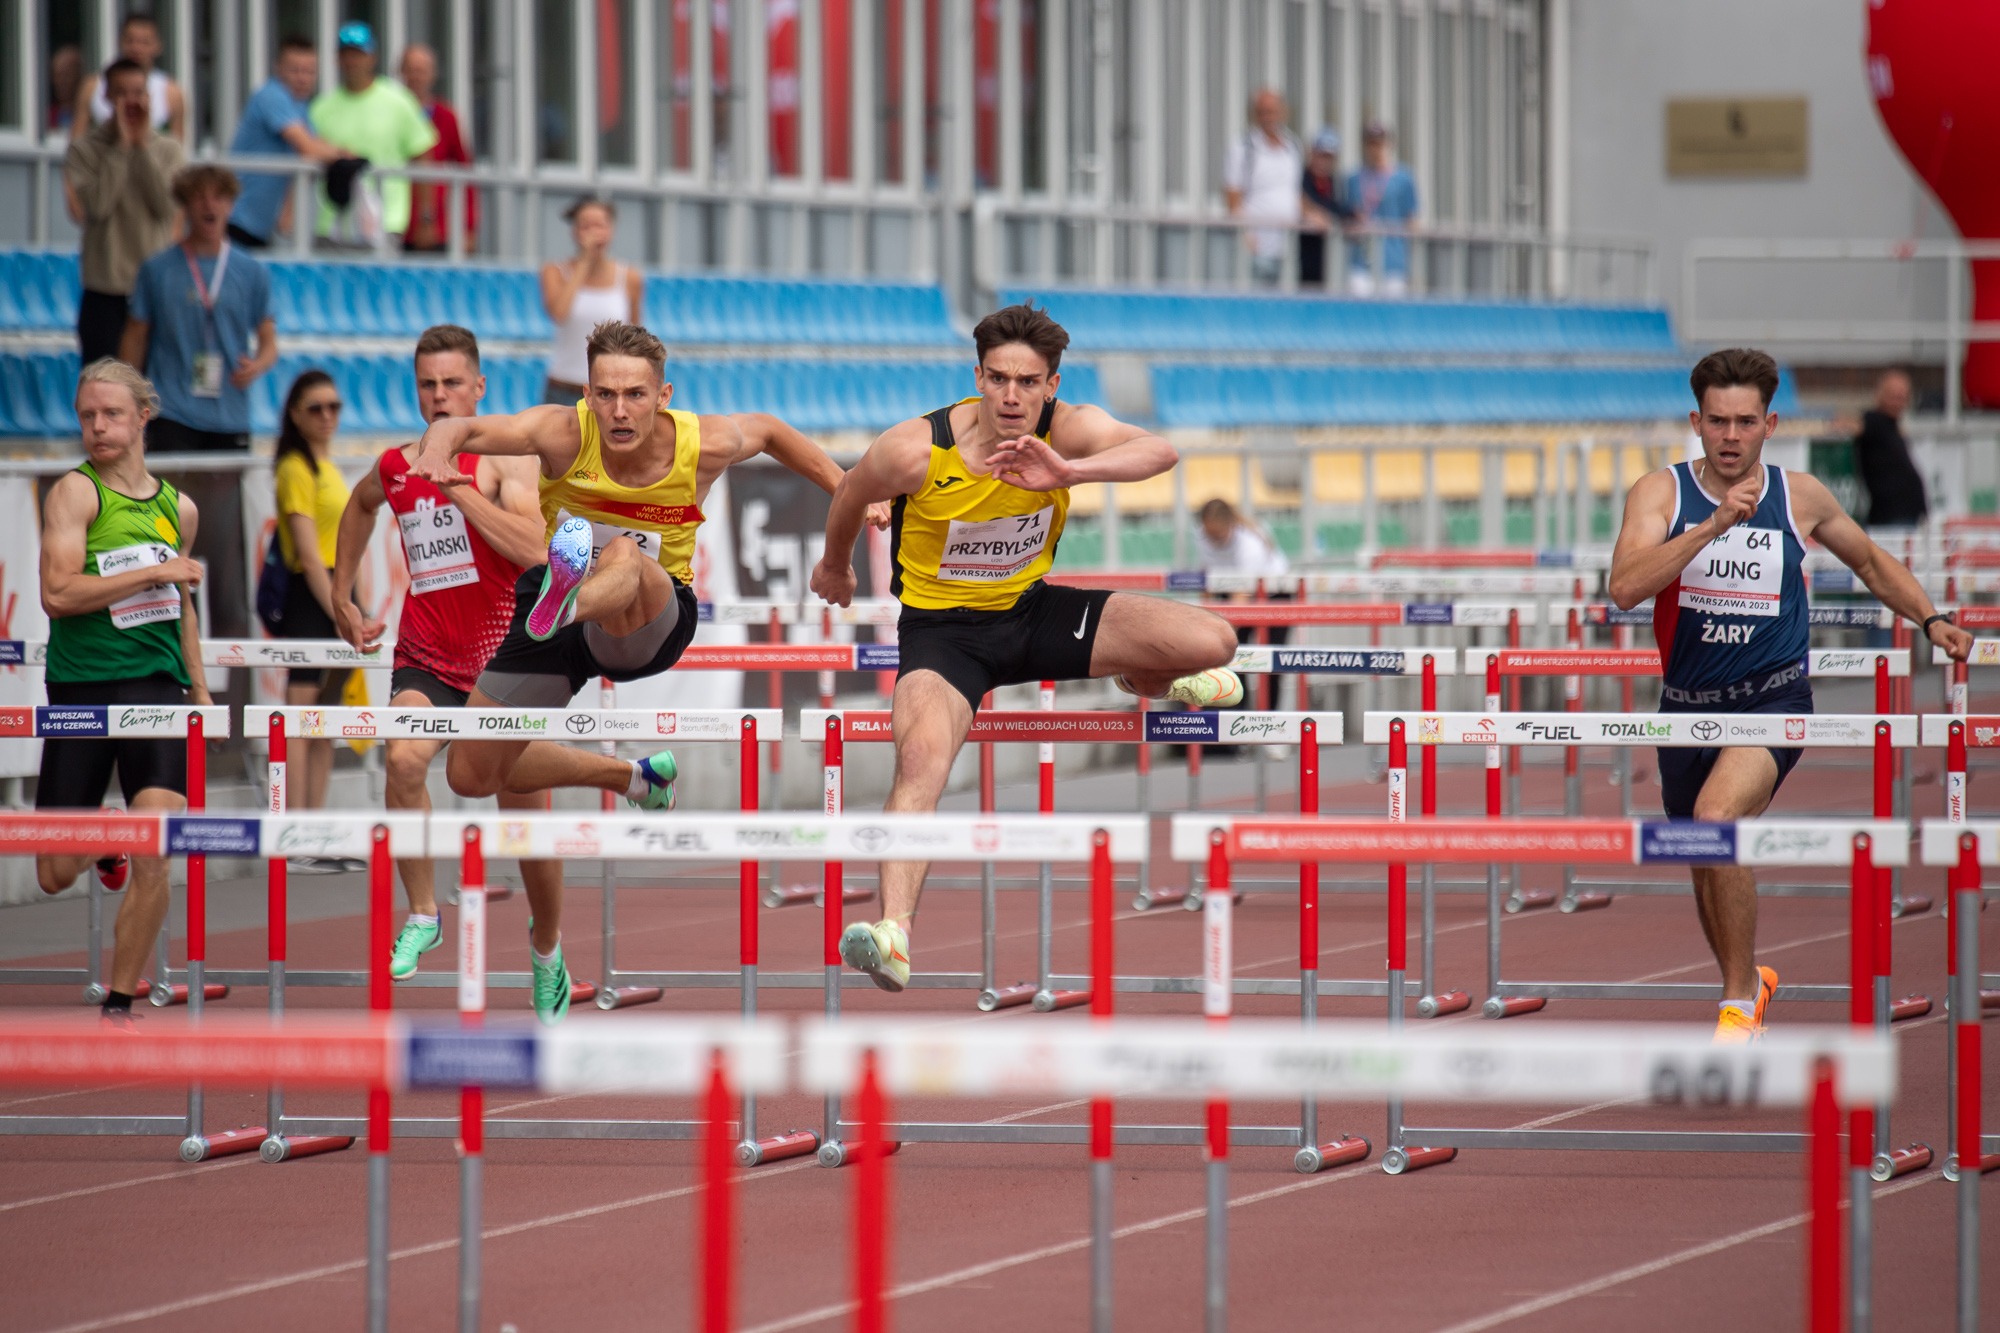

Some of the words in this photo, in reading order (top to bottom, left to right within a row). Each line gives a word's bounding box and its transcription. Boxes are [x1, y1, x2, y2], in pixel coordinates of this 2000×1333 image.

[635, 510, 683, 523] WROCŁAW
[641, 505, 661, 515] MKS
[663, 507, 684, 516] MOS
[433, 508, 453, 528] 65
[1017, 514, 1041, 533] 71
[948, 531, 1045, 556] PRZYBYLSKI
[1746, 531, 1771, 551] 64
[950, 569, 1011, 578] WARSZAWA
[1012, 560, 1032, 574] 2023
[1705, 559, 1761, 581] JUNG
[450, 571, 469, 582] 2023
[1689, 594, 1747, 609] WARSZAWA
[1748, 601, 1770, 610] 2023
[120, 607, 172, 623] WARSZAWA
[1701, 619, 1756, 645] ŻARY
[271, 651, 312, 663] FUEL
[1278, 653, 1365, 667] WARSZAWA
[1507, 655, 1532, 666] PZLA
[1532, 655, 1592, 666] MISTRZOSTWA
[1593, 655, 1622, 666] POLSKI
[1817, 653, 1865, 671] Europol
[17, 716, 24, 725] S
[48, 712, 95, 720] WARSZAWA
[119, 707, 175, 729] Europol
[478, 714, 548, 730] TOTALbet
[1159, 716, 1206, 725] WARSZAWA
[62, 722, 103, 730] CZERWCA
[343, 726, 376, 736] ORLEN
[410, 719, 460, 733] FUEL
[603, 719, 640, 730] Okęcie
[852, 721, 881, 732] PZLA
[970, 721, 992, 731] LSKI
[993, 721, 1004, 731] W
[1004, 721, 1076, 731] WIELOBOJACH
[1077, 721, 1102, 732] U20,
[1103, 721, 1126, 732] U23,
[1127, 721, 1134, 730] S
[1151, 727, 1172, 735] 16-18
[1173, 727, 1214, 735] CZERWCA
[1601, 720, 1672, 737] TOTALbet
[1464, 733, 1495, 742] ORLEN
[1532, 726, 1582, 740] FUEL
[1730, 726, 1767, 737] Okęcie
